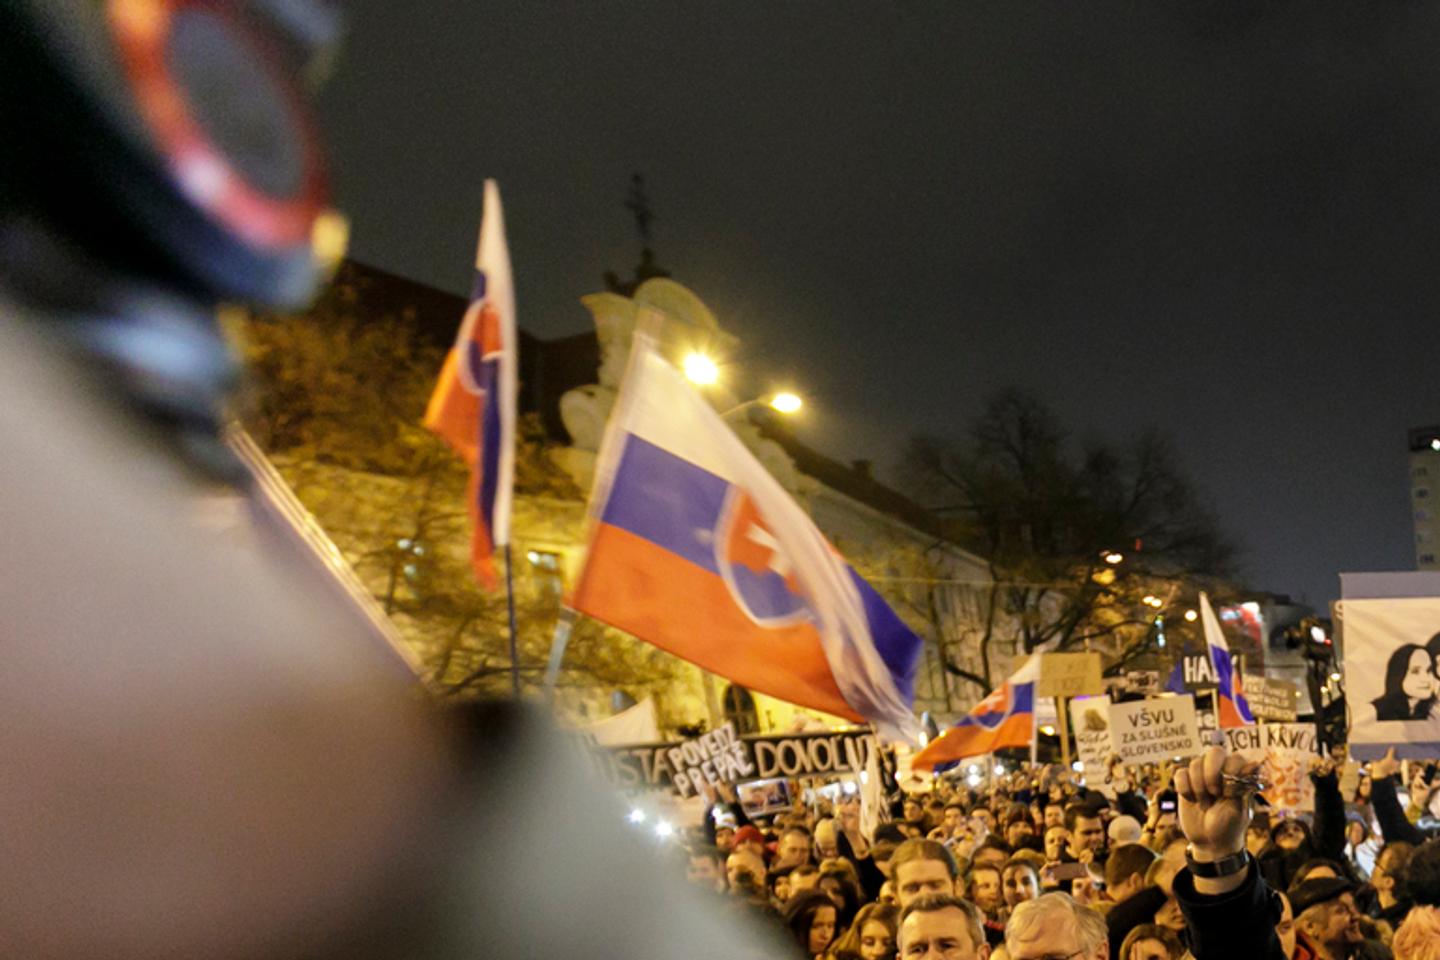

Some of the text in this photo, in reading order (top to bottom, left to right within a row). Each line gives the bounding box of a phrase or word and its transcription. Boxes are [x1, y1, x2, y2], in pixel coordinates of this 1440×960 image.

[1128, 707, 1174, 727] VŠVU
[1120, 738, 1192, 757] SLOVENSKO
[1121, 733, 1137, 744] ZA
